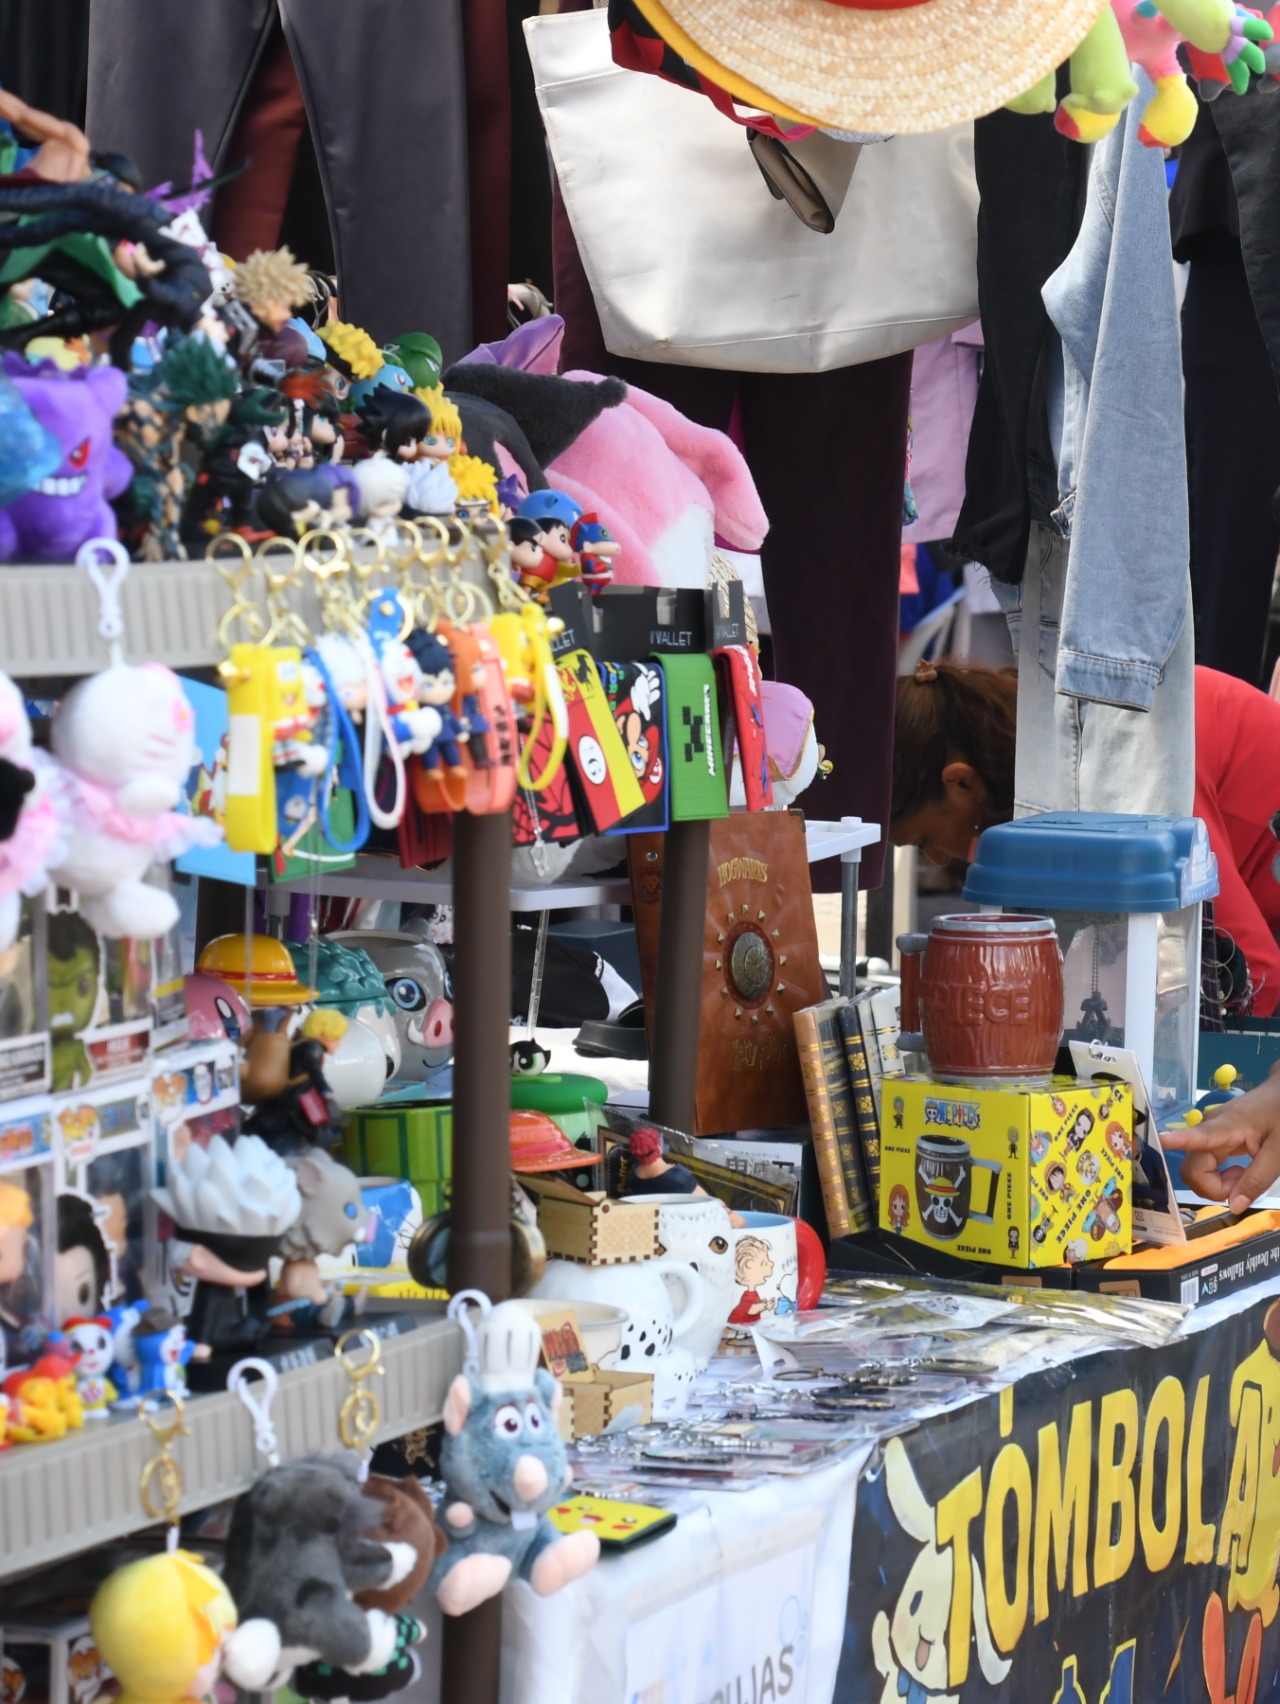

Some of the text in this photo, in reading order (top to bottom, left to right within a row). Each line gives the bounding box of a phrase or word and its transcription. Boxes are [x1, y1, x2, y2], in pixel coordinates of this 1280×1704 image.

[717, 857, 768, 887] HOGWARTS
[1054, 1126, 1066, 1142] ONE
[1055, 1189, 1091, 1245] ONE PIECE
[1245, 1250, 1269, 1273] Deathly
[1270, 1246, 1280, 1263] the
[1218, 1261, 1245, 1282] Hallows
